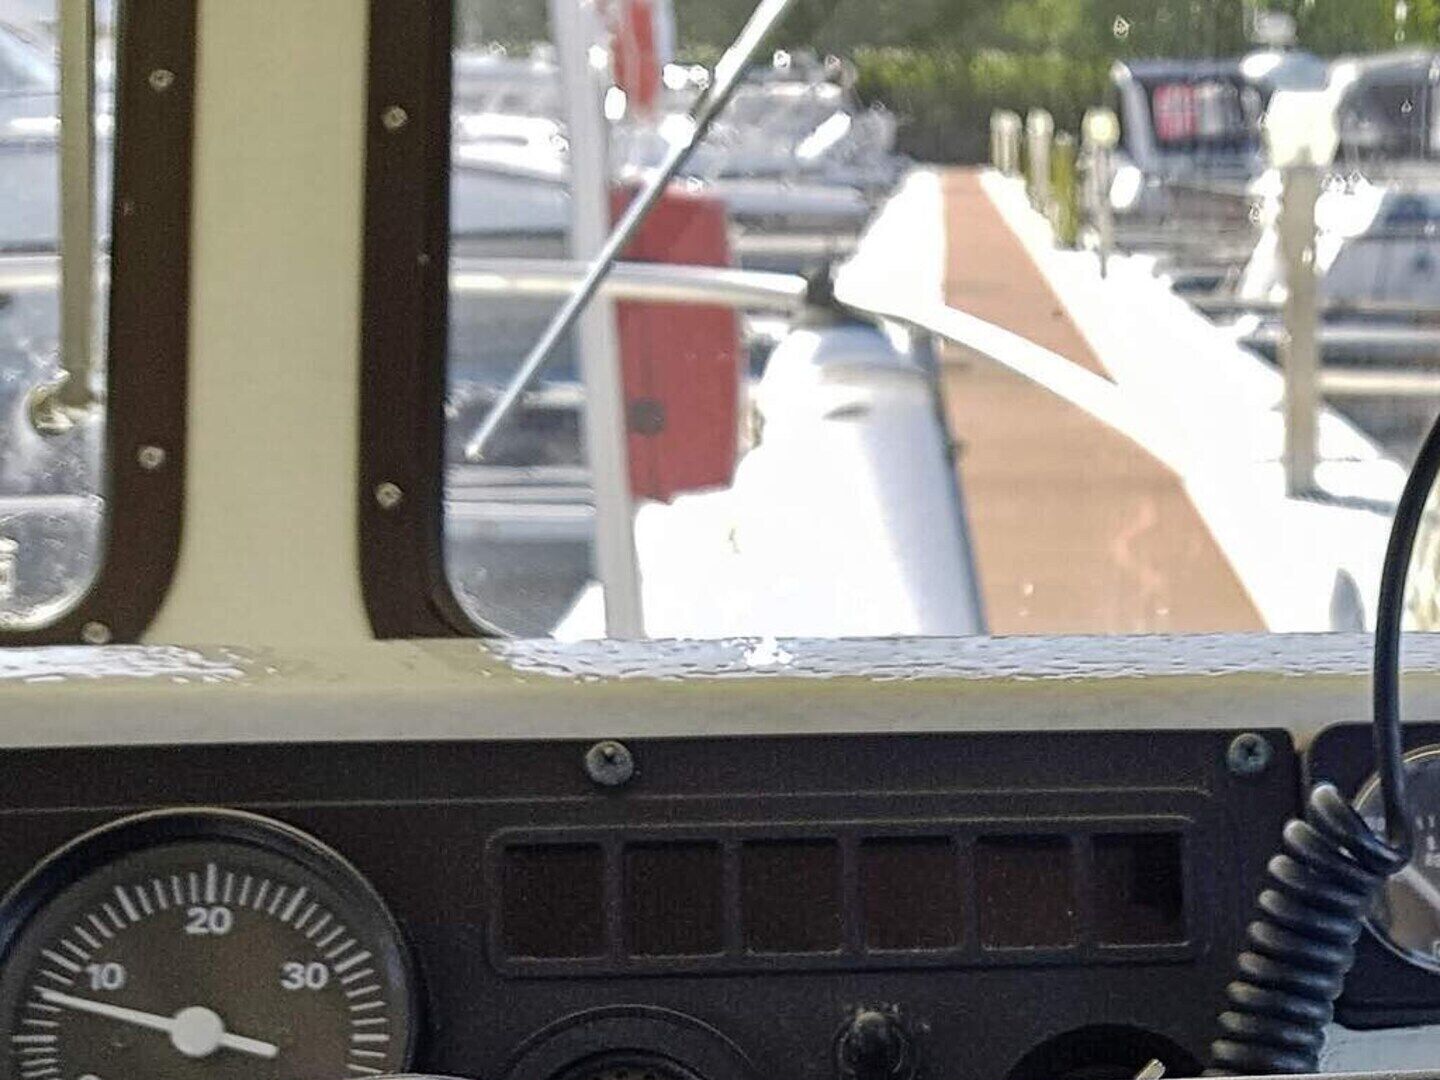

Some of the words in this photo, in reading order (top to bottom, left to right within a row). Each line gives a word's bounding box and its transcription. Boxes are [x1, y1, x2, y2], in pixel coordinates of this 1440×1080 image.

[186, 906, 234, 934] 20
[86, 962, 126, 990] 10
[281, 961, 330, 990] 30
